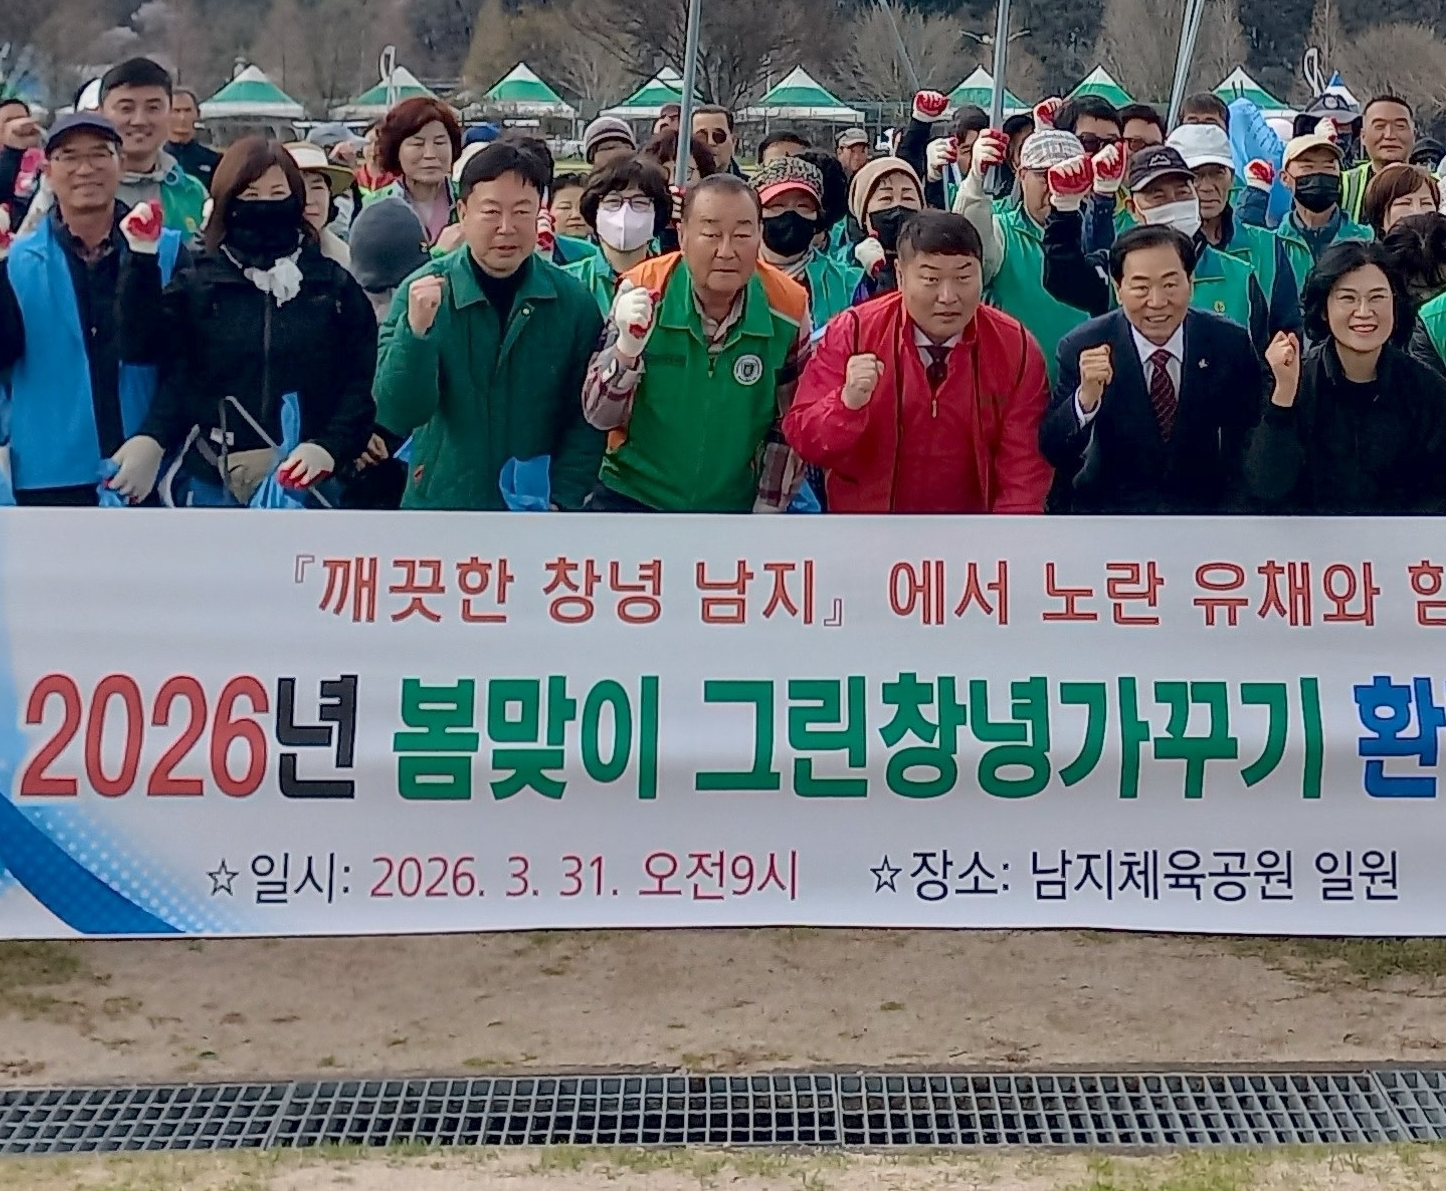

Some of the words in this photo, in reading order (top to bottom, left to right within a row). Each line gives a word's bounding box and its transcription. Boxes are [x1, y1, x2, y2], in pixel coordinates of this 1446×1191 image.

[542, 556, 662, 625] 창녕
[888, 559, 1009, 626] 에서
[1042, 560, 1165, 626] 노란
[1192, 559, 1381, 627] 유채와
[18, 672, 359, 798] 2026년
[392, 674, 660, 801] 봄맞이
[693, 671, 1325, 800] 그린창녕가꾸기
[370, 854, 486, 899] 2026.
[505, 854, 540, 899] 3.
[559, 853, 620, 898] 31.
[638, 849, 800, 902] 오전9시
[1030, 847, 1296, 902] 남지체육공원
[1313, 849, 1400, 902] 일원
